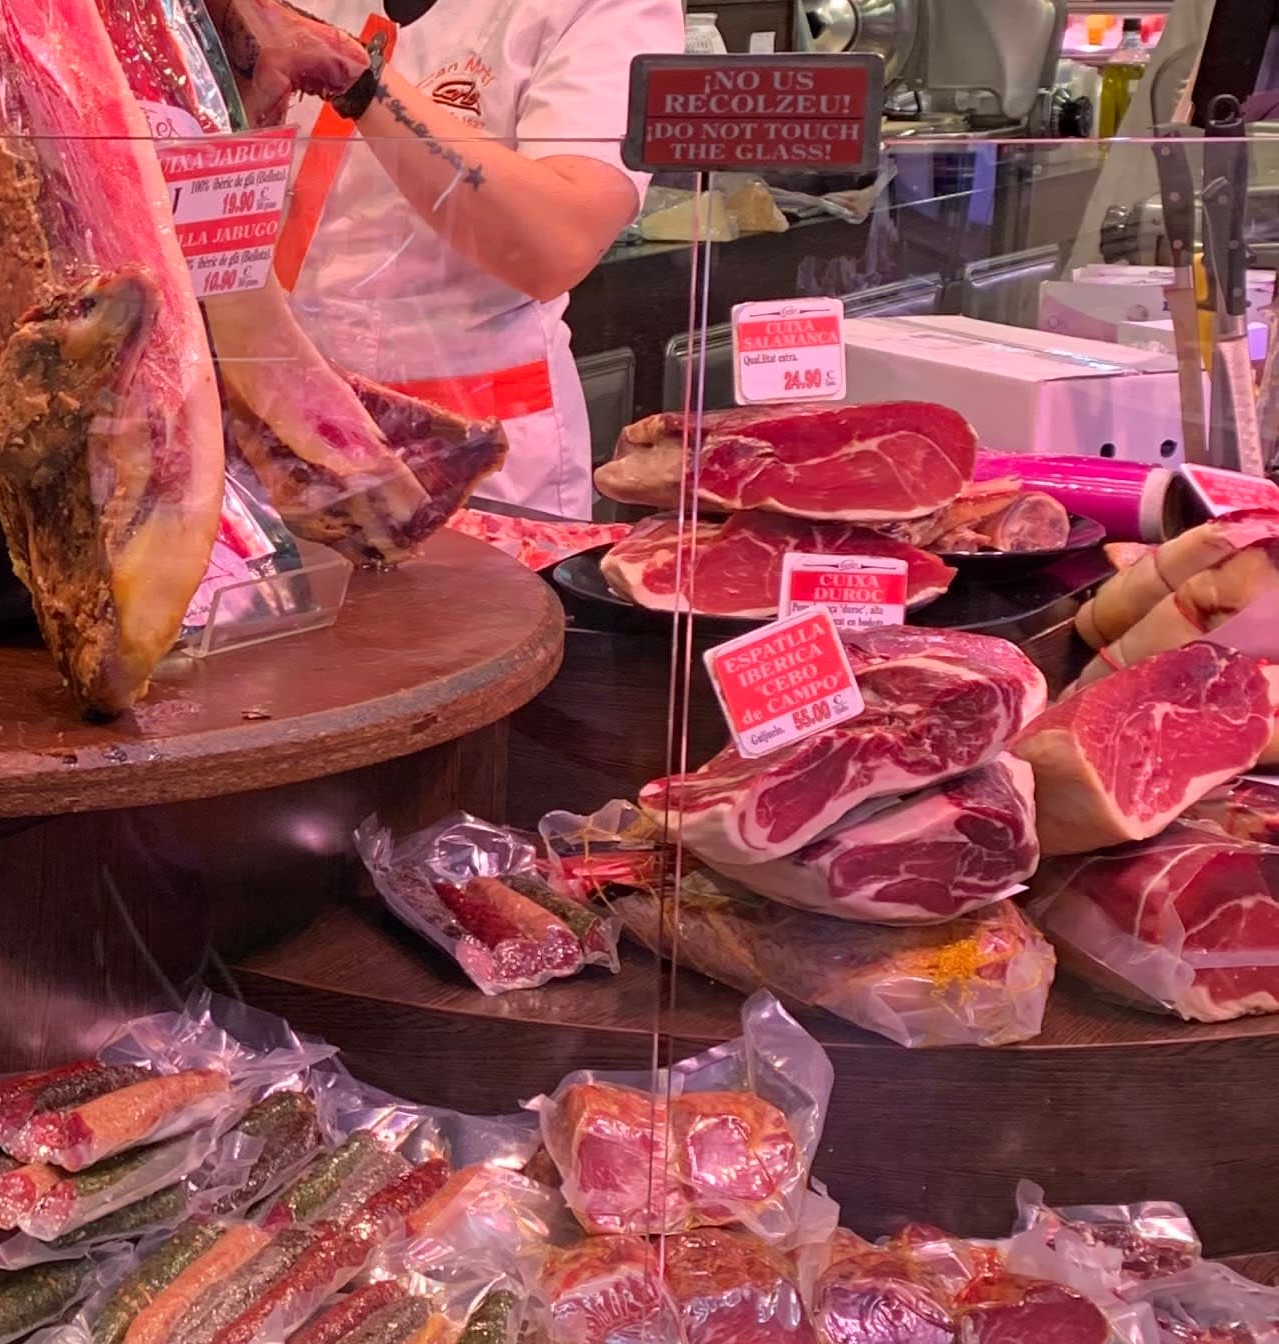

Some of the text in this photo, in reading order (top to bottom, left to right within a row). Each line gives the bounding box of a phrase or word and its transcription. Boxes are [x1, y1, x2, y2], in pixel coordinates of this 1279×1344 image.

[703, 71, 814, 95] ¡NO US
[664, 95, 851, 114] RECOLZEU!
[646, 123, 860, 142] ¡DO NOT TOUCH
[209, 140, 292, 168] JABUGO
[671, 143, 832, 160] THE GLASS!
[191, 180, 210, 194] 100%
[234, 176, 242, 187] de
[222, 190, 255, 214] 19.90
[213, 220, 278, 242] JABUGO
[203, 269, 237, 292] 10.90
[766, 320, 815, 334] CUIXA
[744, 331, 838, 349] SALAMANCA
[784, 368, 821, 390] 24.90
[819, 575, 879, 587] CUIXA
[814, 588, 885, 602] DUROC
[724, 623, 825, 674] ESPATLLA
[742, 708, 762, 725] de
[792, 700, 832, 732] 55.00
